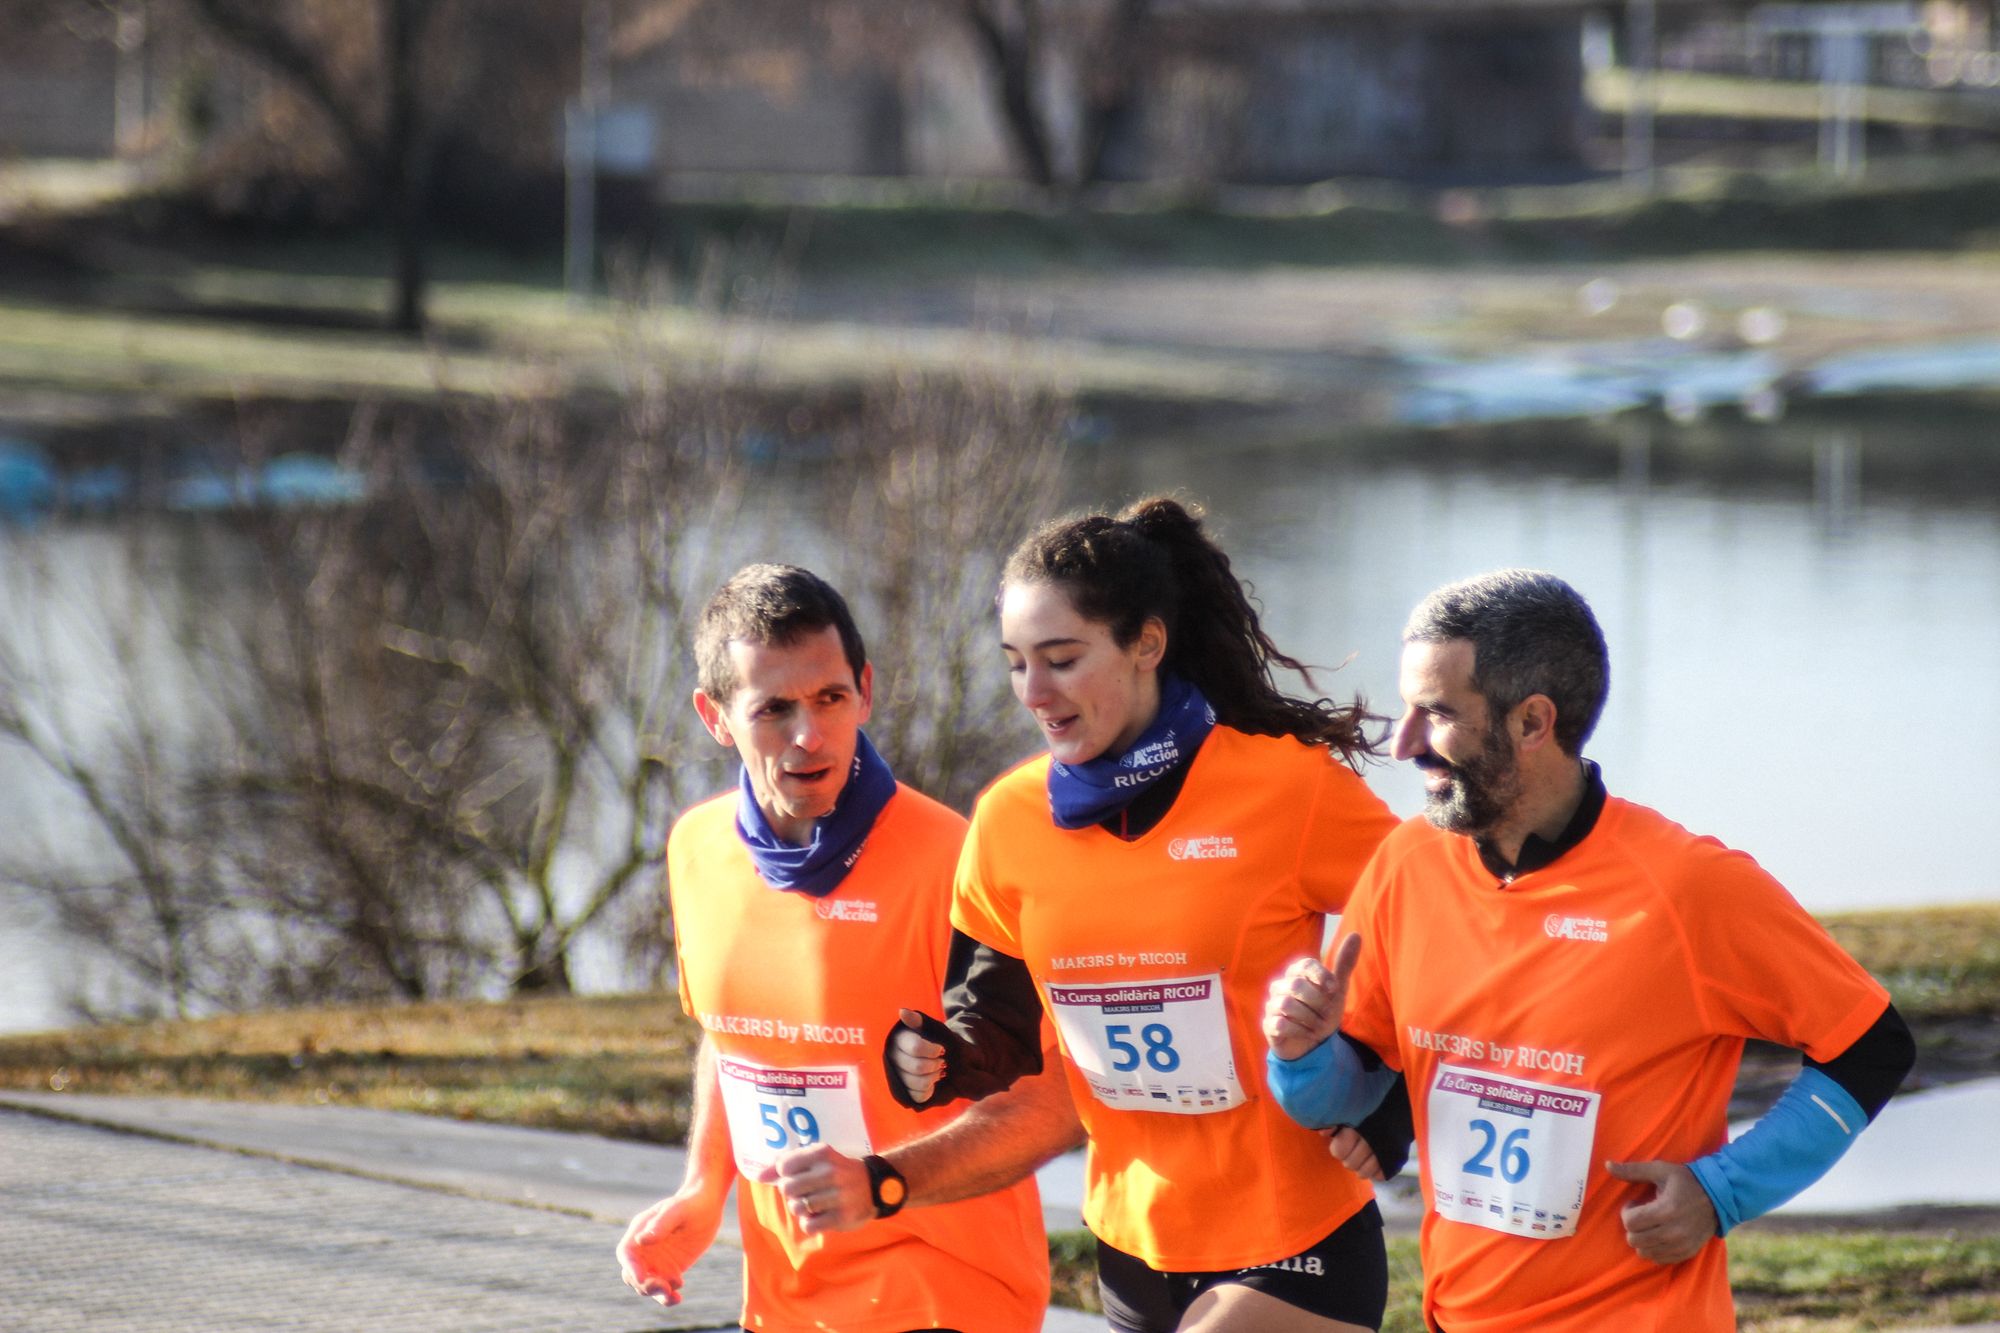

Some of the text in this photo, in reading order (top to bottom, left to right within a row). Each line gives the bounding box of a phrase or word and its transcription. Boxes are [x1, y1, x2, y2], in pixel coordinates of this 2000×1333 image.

[1163, 740, 1174, 748] en
[1133, 748, 1179, 767] Acción
[1183, 840, 1237, 859] Acción
[828, 900, 878, 922] Acción
[1557, 918, 1608, 942] Acción
[1051, 953, 1187, 969] MAK3RS by RICOH
[1068, 992, 1102, 1002] Cursa
[1105, 989, 1160, 1002] solidària
[1163, 985, 1205, 999] RICOH
[700, 1012, 865, 1045] MAK3RS by RICOH
[1105, 1023, 1180, 1073] 58
[1408, 1026, 1585, 1076] MAK3RS by RICOH
[806, 1075, 843, 1086] RICOH
[1455, 1078, 1485, 1094] Cursa
[1486, 1084, 1534, 1104] solidària
[1537, 1094, 1584, 1113] RICOH
[759, 1103, 820, 1149] 59
[1462, 1119, 1531, 1184] 26
